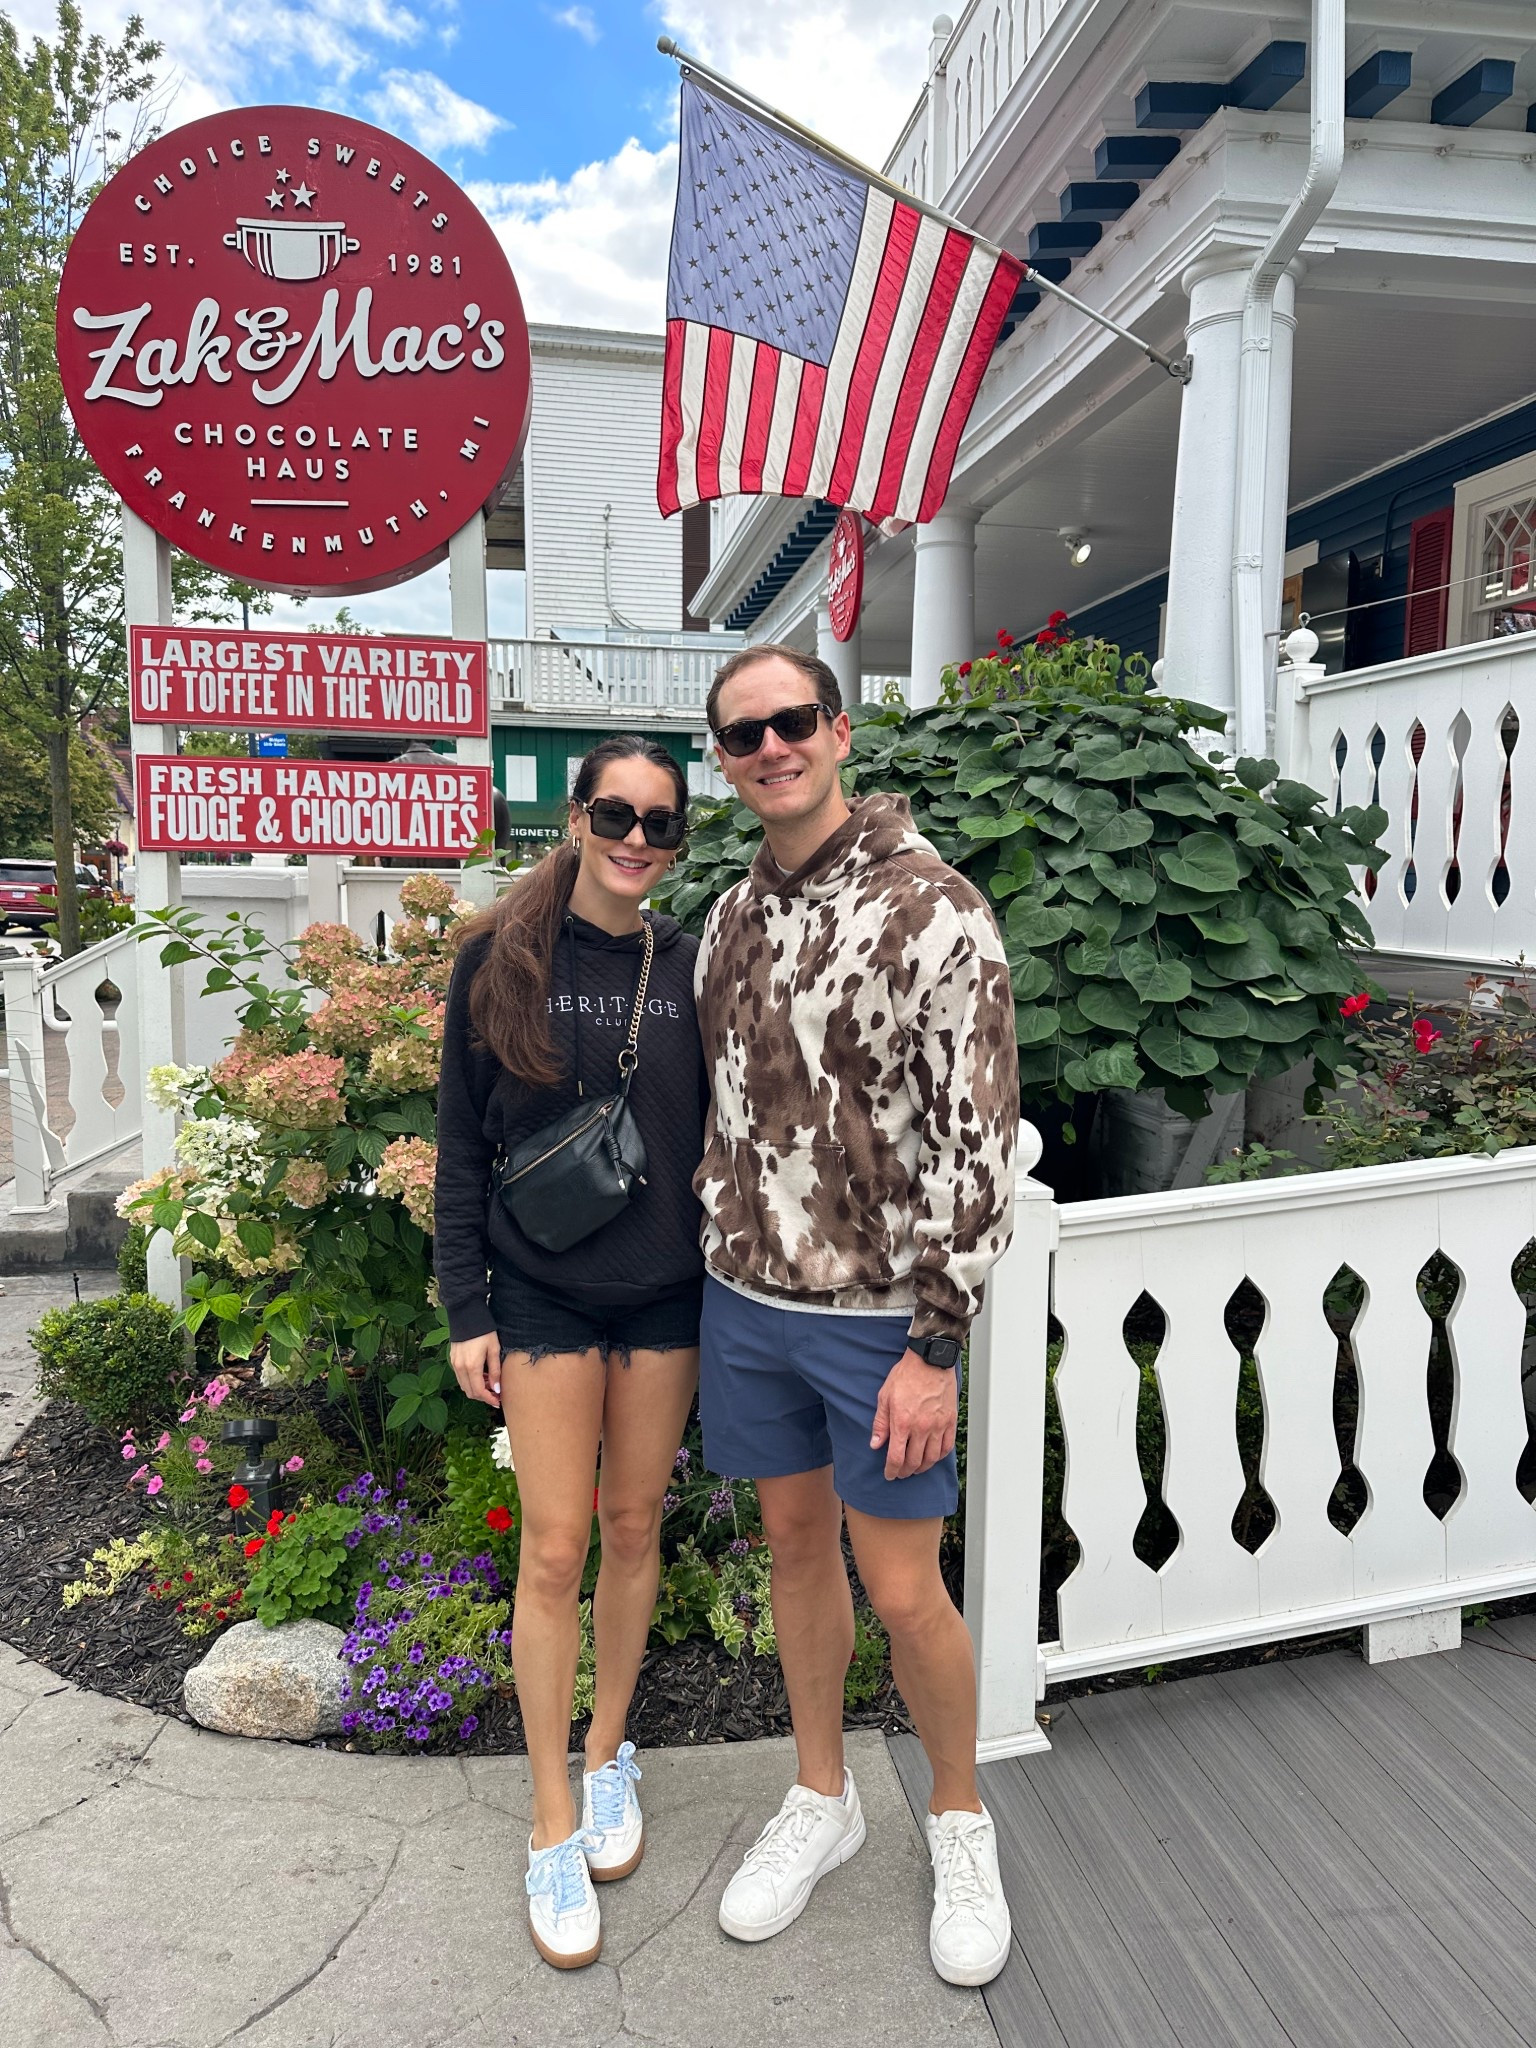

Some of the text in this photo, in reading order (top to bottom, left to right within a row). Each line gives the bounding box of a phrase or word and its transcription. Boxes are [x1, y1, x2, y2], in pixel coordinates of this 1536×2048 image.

[134, 134, 449, 229] CHOICE SWEETS
[119, 242, 196, 265] EST.
[388, 253, 462, 275] 1981
[174, 422, 419, 449] CHOCOLATE
[459, 415, 490, 460] MI
[247, 456, 350, 480] HAUS
[141, 637, 476, 681] LARGEST VARIETY
[140, 668, 474, 725] OF TOFFEE IN THE WORLD
[149, 764, 479, 803] FRESH HANDMADE
[149, 793, 479, 849] FUDGE & CHOCOLATES
[595, 1017, 628, 1027] CLU
